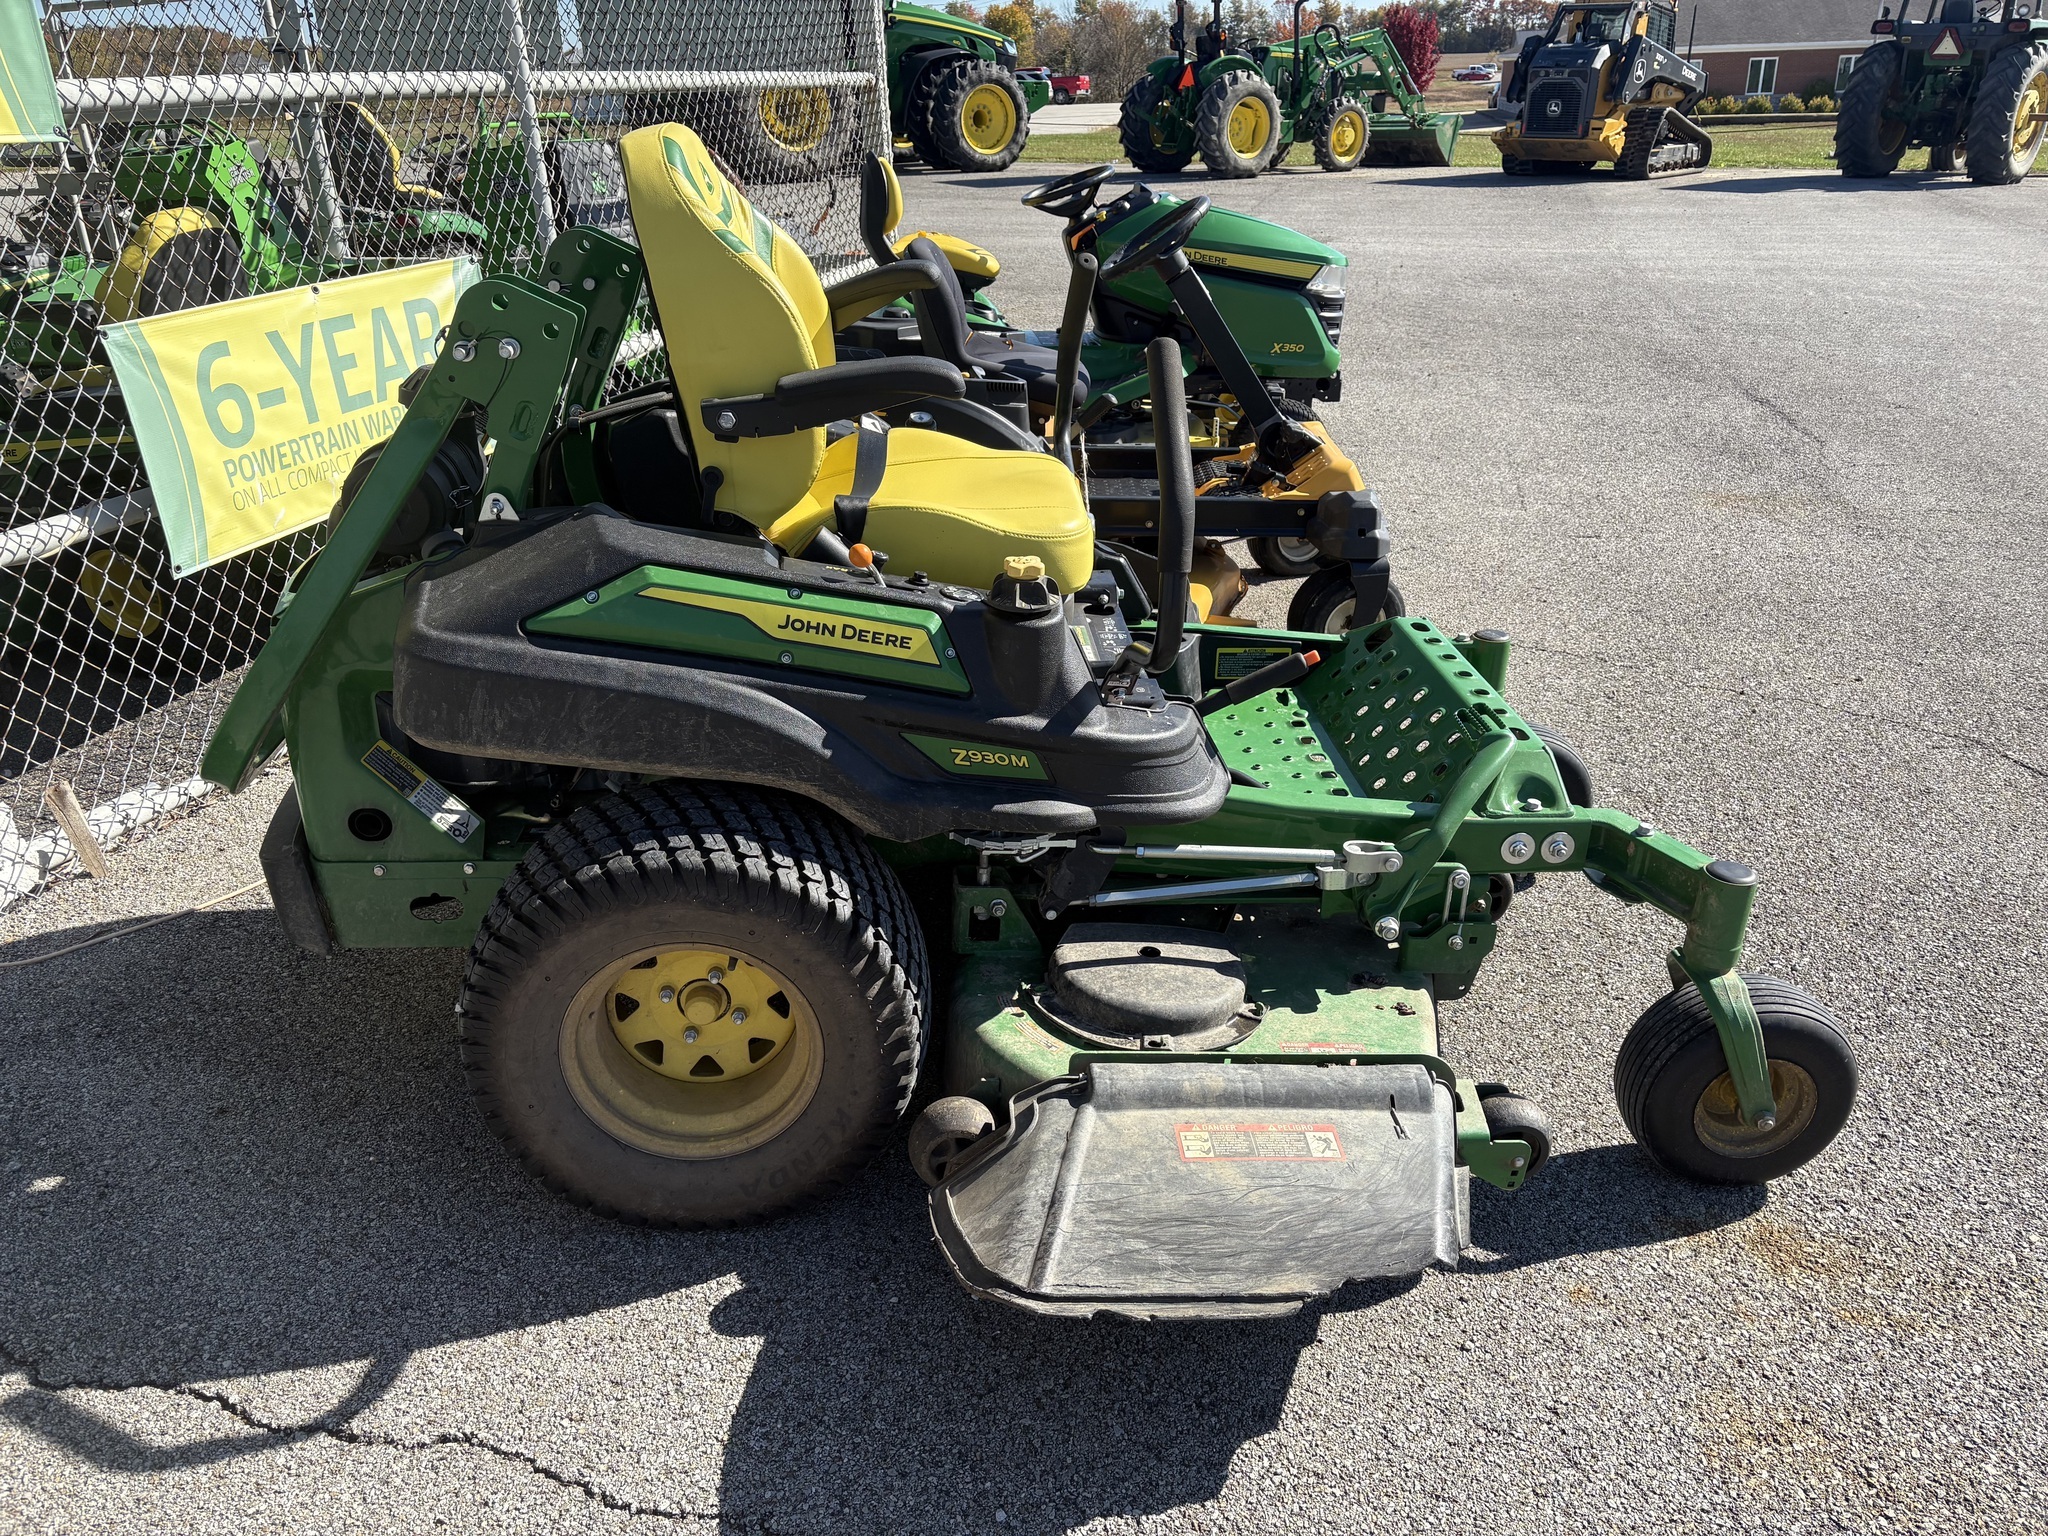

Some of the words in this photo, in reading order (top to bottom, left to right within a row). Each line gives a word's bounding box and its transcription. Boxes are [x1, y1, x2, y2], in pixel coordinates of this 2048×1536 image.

[1682, 65, 1697, 82] DEERE
[1194, 251, 1228, 265] DEERE
[1270, 342, 1305, 354] X350
[196, 298, 441, 449] 6-YEAR
[223, 419, 360, 489] POWERTRAIN
[232, 486, 257, 511] ON
[260, 476, 286, 500] ALL
[287, 452, 351, 491] COMPACT
[778, 614, 836, 637] JOHN
[841, 623, 912, 650] DEERE
[392, 751, 416, 774] CAUTION
